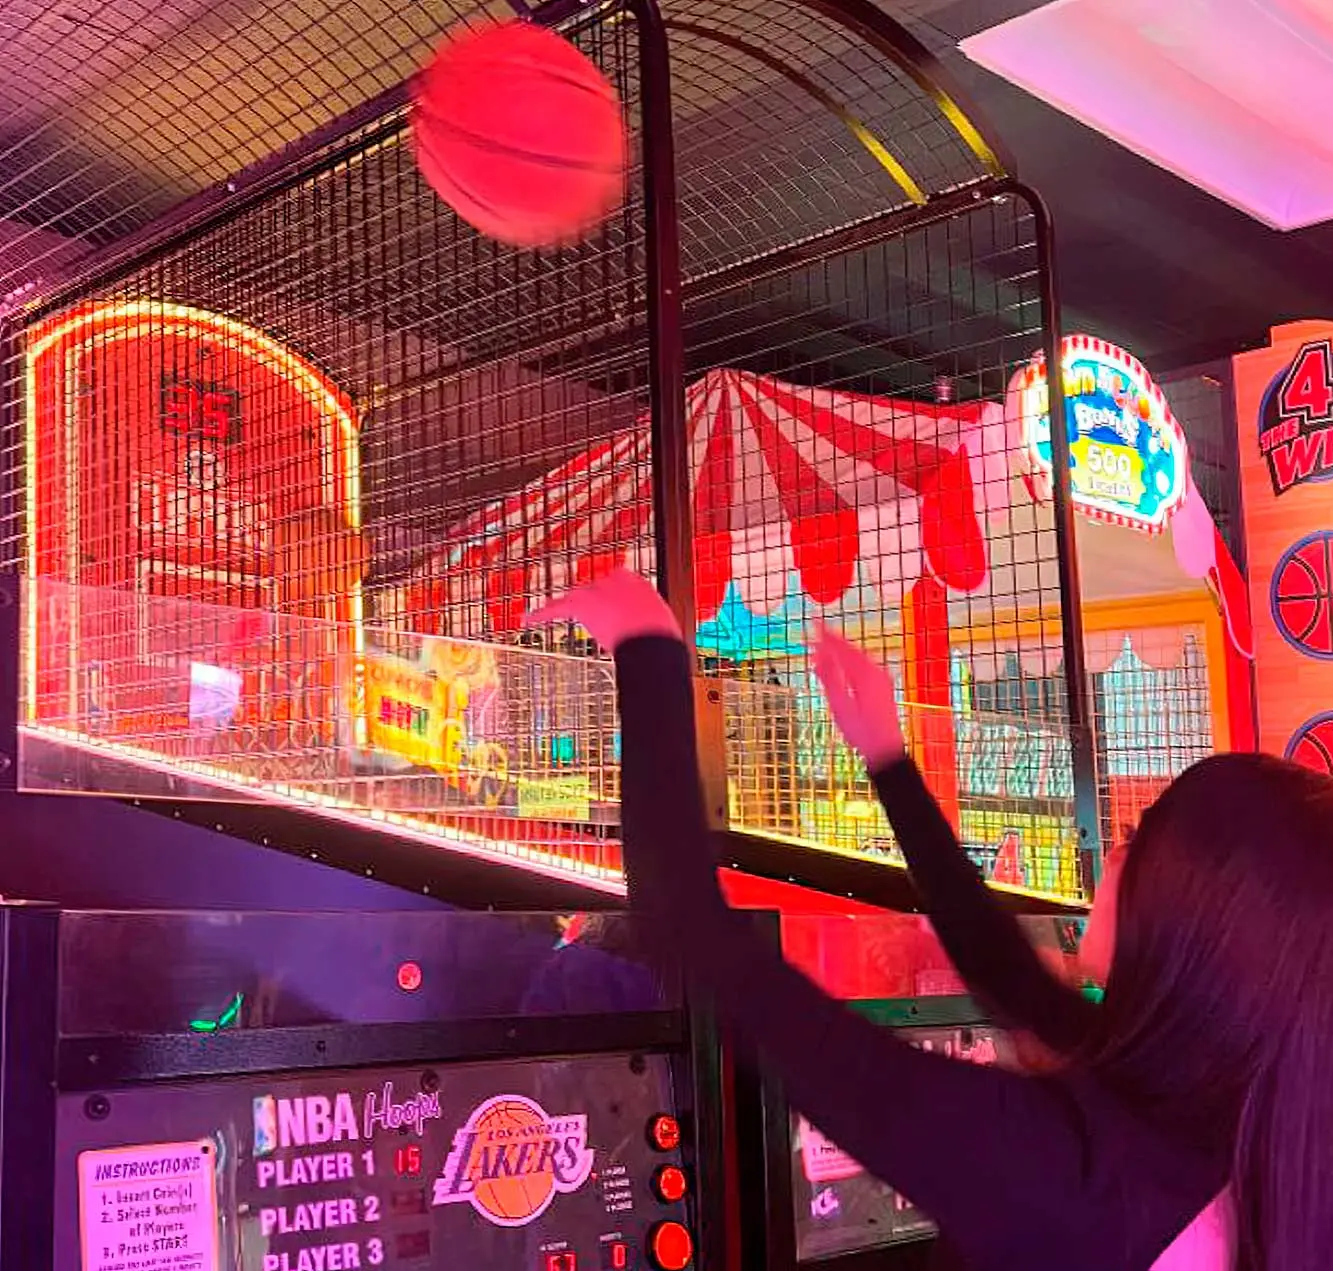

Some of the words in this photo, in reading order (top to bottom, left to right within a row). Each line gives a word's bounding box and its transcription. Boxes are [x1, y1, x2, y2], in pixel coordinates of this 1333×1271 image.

[1261, 417, 1299, 451] THE
[1088, 445, 1131, 477] 500
[278, 1093, 359, 1147] NBA
[364, 1082, 441, 1139] Hoops
[257, 1152, 354, 1188] PLAYER
[361, 1150, 375, 1175] 1
[396, 1146, 421, 1175] 15
[449, 1132, 581, 1195] LAKERS
[260, 1198, 358, 1236] PLAYER
[364, 1196, 381, 1222] 2
[263, 1242, 360, 1271] PLAYER
[367, 1238, 384, 1264] 3
[613, 1244, 627, 1269] 0
